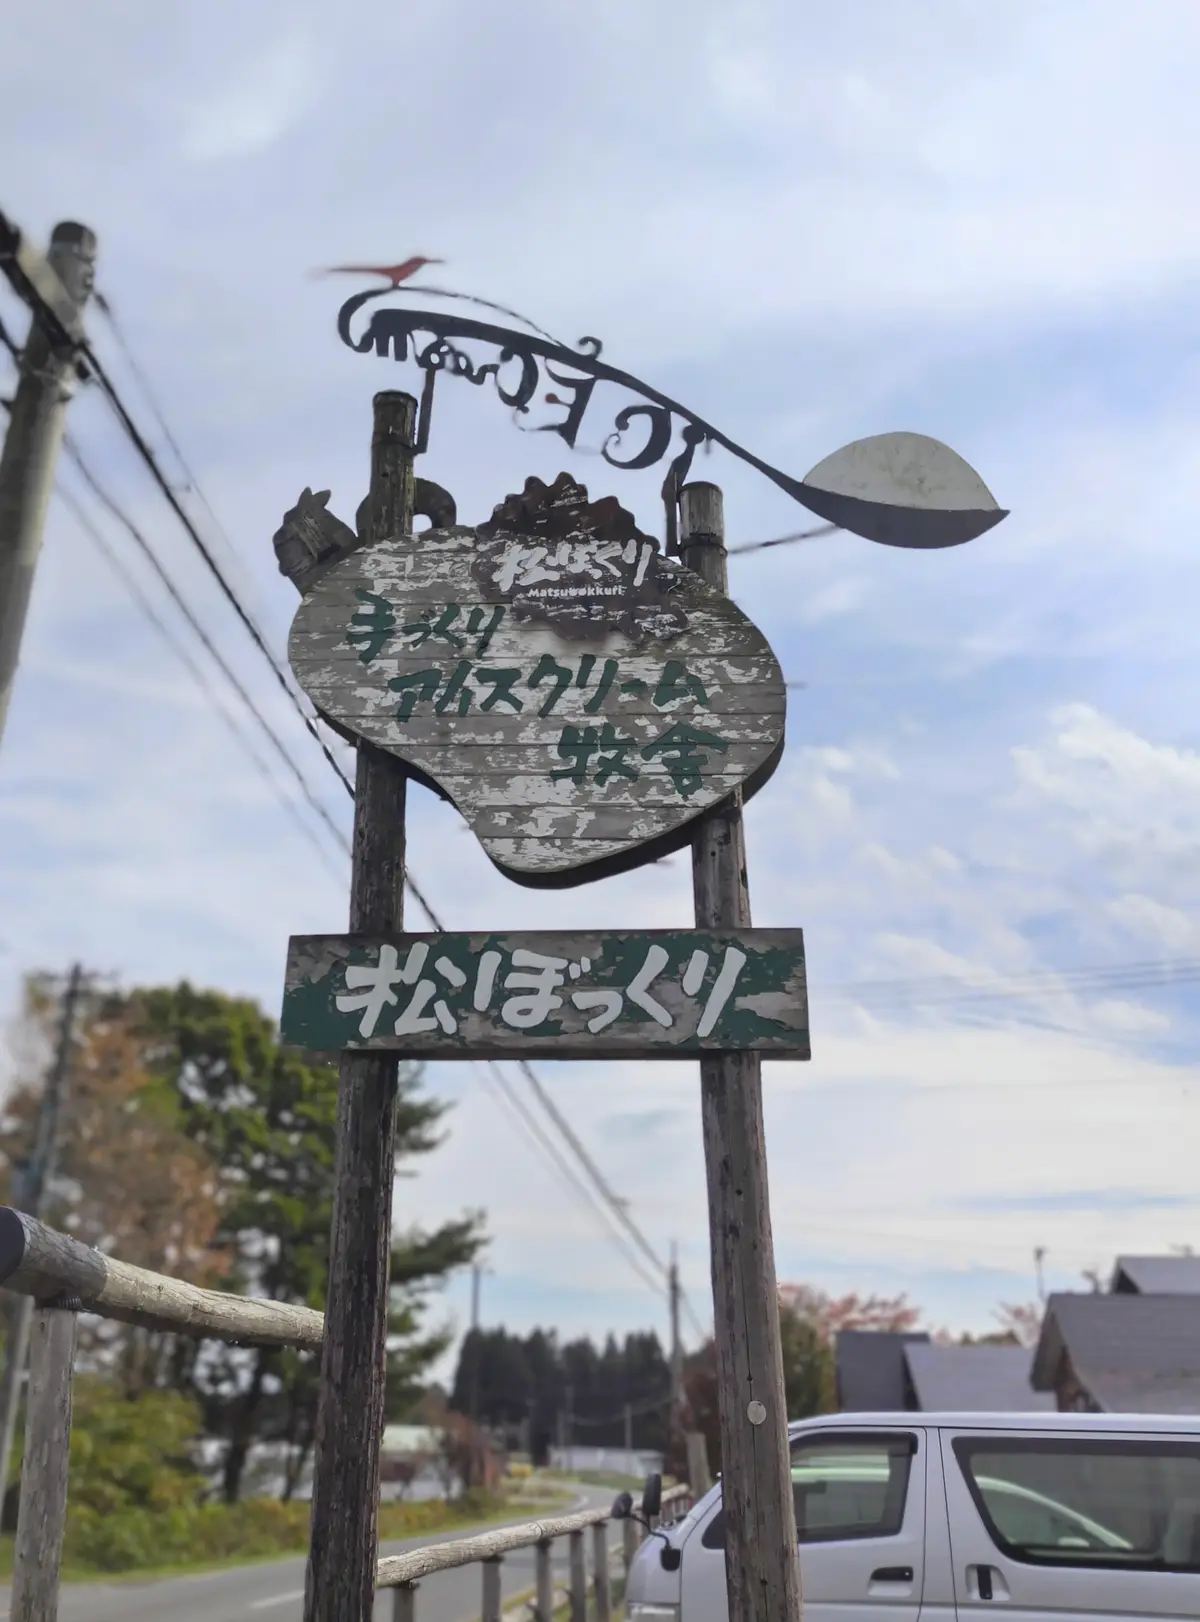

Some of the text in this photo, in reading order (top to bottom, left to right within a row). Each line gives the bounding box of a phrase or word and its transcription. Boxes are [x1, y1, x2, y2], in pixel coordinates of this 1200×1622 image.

[388, 653, 709, 722] アイスクリーム
[336, 941, 747, 1038] 松ぼっくり
